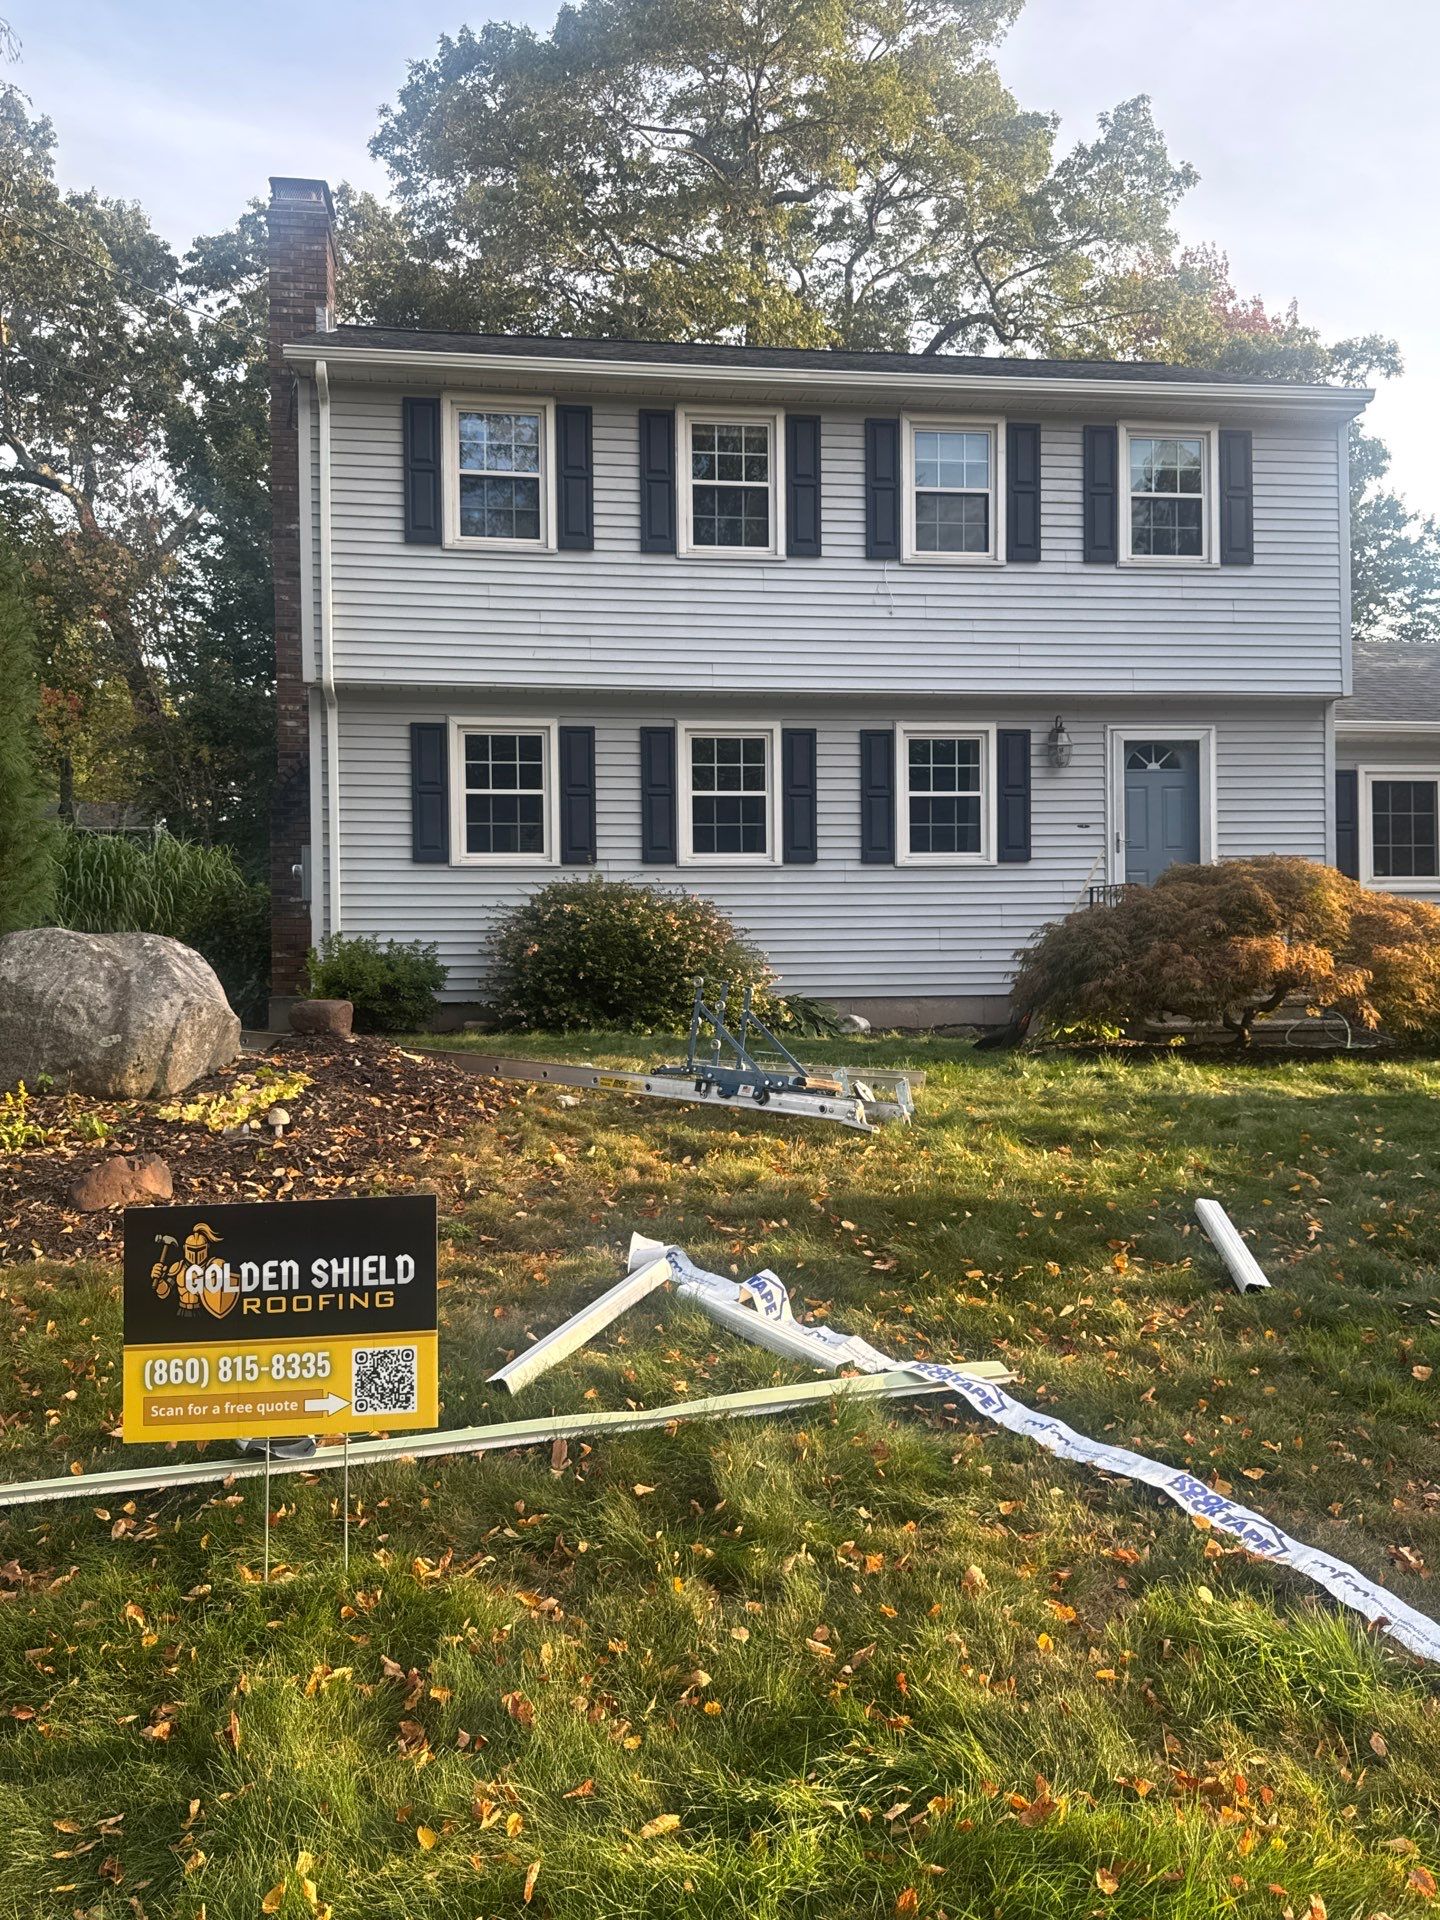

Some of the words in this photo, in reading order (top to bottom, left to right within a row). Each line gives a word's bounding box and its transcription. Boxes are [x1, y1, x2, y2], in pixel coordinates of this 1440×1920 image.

[185, 1259, 300, 1295] GOLDEN
[311, 1254, 415, 1289] SHIELD
[243, 1291, 394, 1314] ROOFING
[144, 1357, 209, 1390] (860)
[218, 1352, 330, 1382] 815-8335
[151, 1405, 184, 1417] Scan
[187, 1403, 209, 1415] for
[212, 1406, 220, 1414] a
[224, 1401, 253, 1414] free
[257, 1400, 298, 1414] quote
[1173, 1474, 1237, 1512] ROOF
